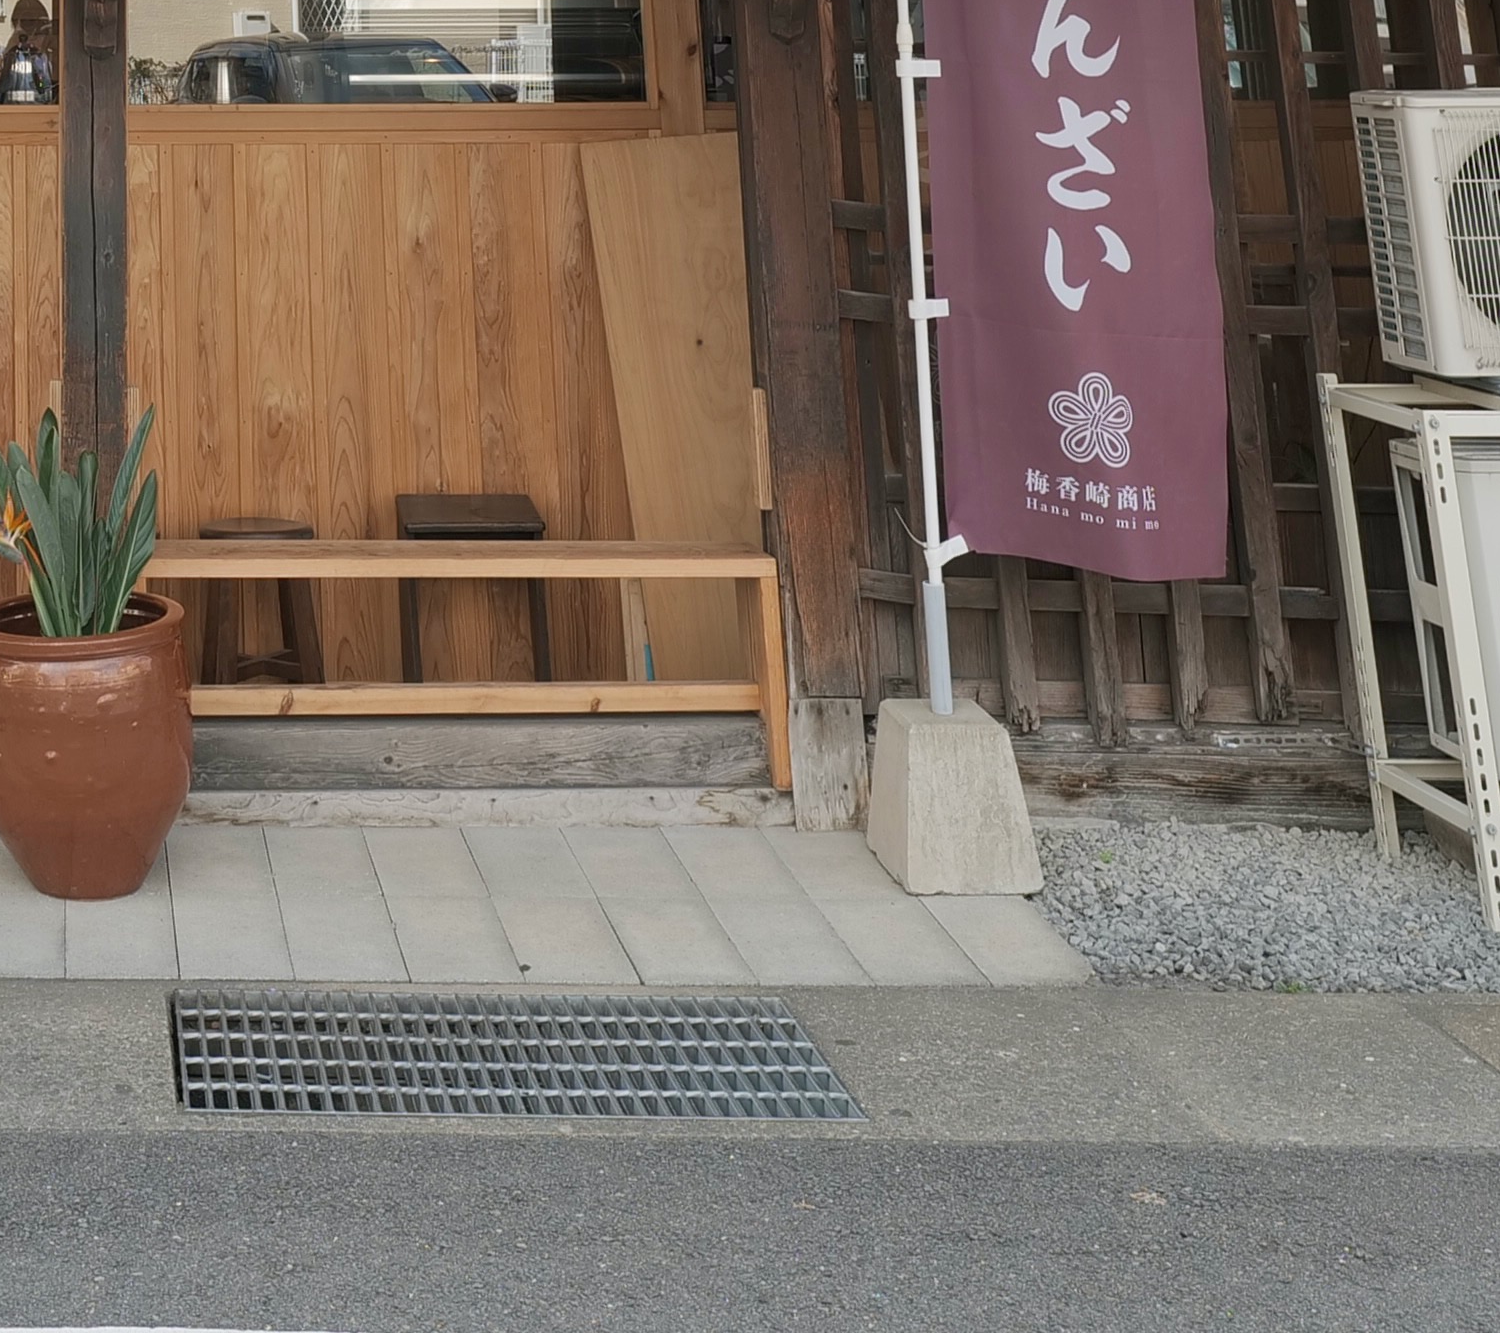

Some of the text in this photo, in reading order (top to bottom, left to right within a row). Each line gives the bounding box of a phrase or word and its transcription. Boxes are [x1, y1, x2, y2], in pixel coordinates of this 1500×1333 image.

[1025, 468, 1156, 512] 梅香崎商店
[1026, 497, 1070, 517] Hana
[1080, 511, 1104, 525] mo
[1116, 516, 1137, 530] mi
